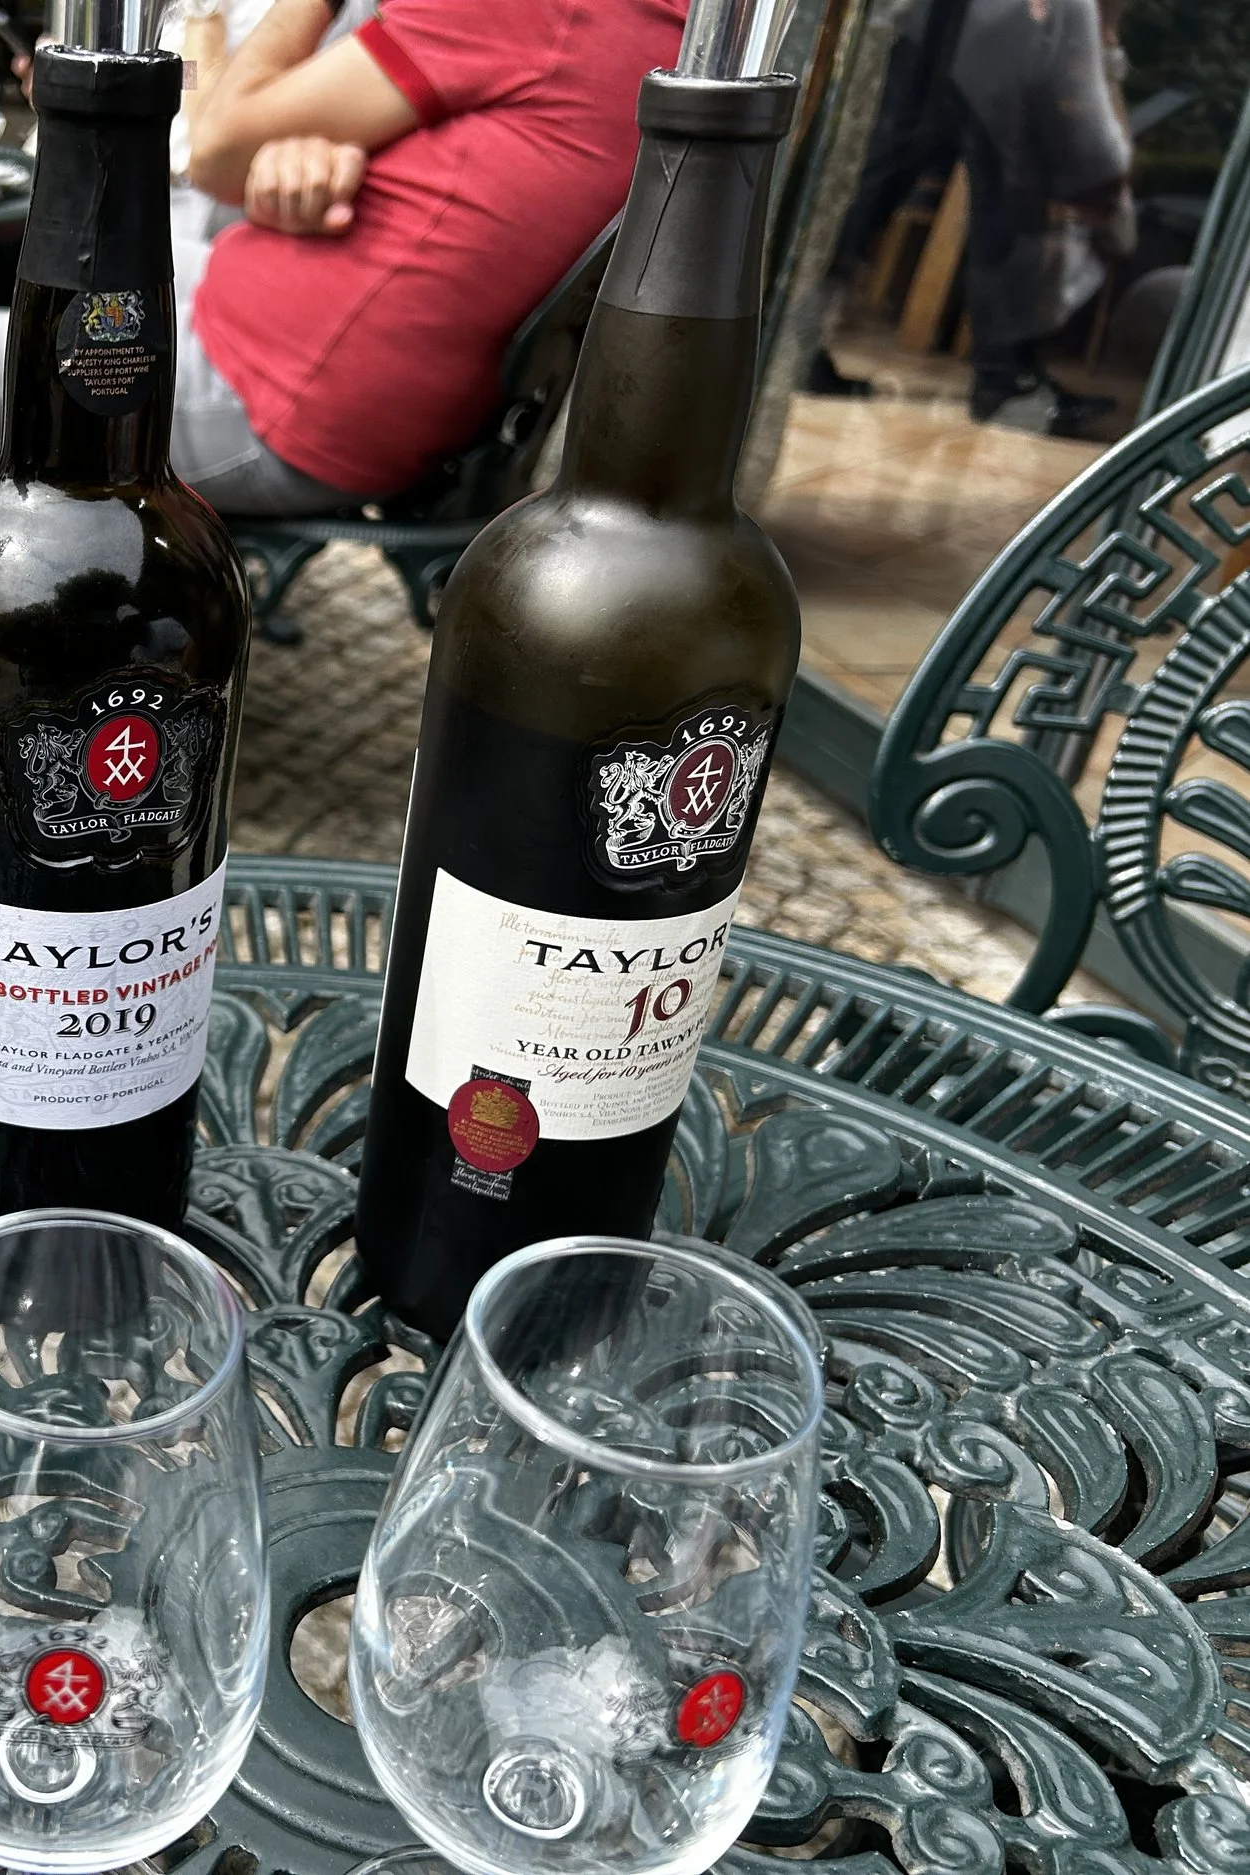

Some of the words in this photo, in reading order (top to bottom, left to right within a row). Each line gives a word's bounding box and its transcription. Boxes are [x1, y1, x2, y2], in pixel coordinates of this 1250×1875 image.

[85, 347, 134, 356] APPOINTMENT
[136, 346, 145, 354] TO
[103, 357, 121, 366] KING
[122, 355, 150, 365] CHARLES
[84, 378, 116, 387] TAYLOR'S
[117, 376, 135, 386] PORT
[104, 367, 114, 376] OF
[115, 367, 133, 375] PORT
[133, 365, 149, 373] WINE
[91, 387, 128, 396] PORTUGAL
[91, 688, 164, 716] 1692
[681, 715, 747, 746] 1692
[49, 818, 109, 835] TAYLOR
[123, 808, 181, 825] FLADGATE
[620, 845, 680, 865] TAYLOR
[690, 835, 735, 852] FLADGATE
[115, 955, 201, 1001] VINTAGE
[56, 1003, 157, 1037] 2019
[620, 978, 693, 1047] 10
[55, 1046, 130, 1060] FLADGATE
[135, 1043, 144, 1051] &
[149, 1016, 195, 1046] YEATMAN
[515, 1039, 579, 1060] YEAR
[586, 1047, 632, 1061] OLD
[638, 1024, 694, 1057] TAWNY
[11, 1063, 35, 1073] and
[36, 1064, 86, 1078] Vineyard
[88, 1061, 127, 1075] Bottlers
[130, 1051, 160, 1068] Vinhos
[537, 1064, 593, 1083] Aged
[586, 1067, 617, 1084] for
[618, 1065, 638, 1079] 10
[634, 1058, 671, 1080] years
[33, 1095, 91, 1104] PRODUCT
[93, 1094, 109, 1102] OF
[112, 1078, 164, 1099] PORTUGAL
[31, 1629, 109, 1650] 1692
